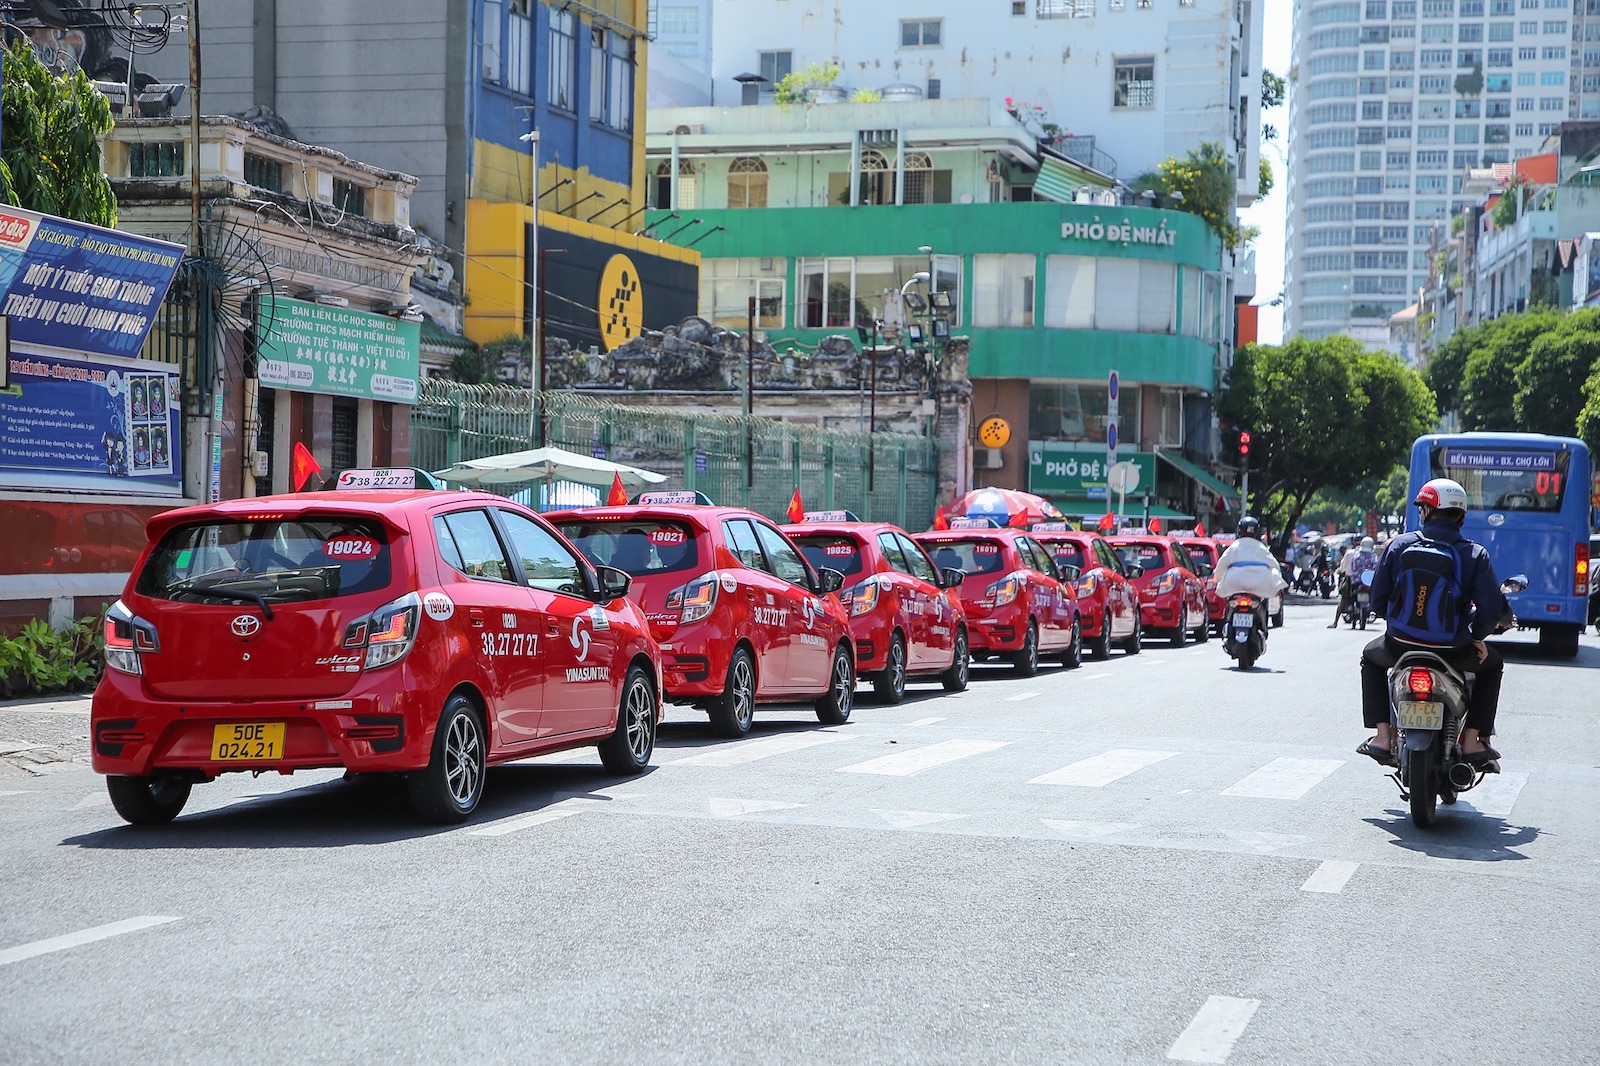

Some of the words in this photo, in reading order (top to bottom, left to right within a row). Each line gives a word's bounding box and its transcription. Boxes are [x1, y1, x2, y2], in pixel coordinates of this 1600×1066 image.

[6, 219, 27, 240] dục
[1061, 215, 1104, 240] PHỞ
[1107, 217, 1131, 247] ĐỆ
[1132, 217, 1177, 246] NHẤT
[47, 230, 64, 244] GIÁO
[94, 240, 108, 255] TẠO
[107, 242, 129, 257] THÀNH
[159, 255, 177, 268] MINH
[22, 262, 55, 290] MỘT
[50, 265, 65, 288] Ý
[59, 269, 94, 294] THỨC
[90, 276, 120, 299] GIAO
[117, 280, 155, 305] THÔNG
[2, 293, 42, 321] TRIỆU
[37, 300, 60, 325] NỤ
[56, 301, 89, 326] CƯỜI
[83, 307, 119, 333] HẠNH
[114, 312, 147, 336] PHÚC
[291, 306, 310, 317] BAN
[311, 308, 331, 320] LIÊN
[333, 312, 349, 324] LẠC
[350, 315, 366, 327] HỌC
[368, 319, 385, 330] SINH
[278, 317, 313, 331] TRƯỜNG
[315, 323, 337, 335] THCS
[339, 327, 361, 339] MẠCH
[364, 328, 384, 342] KIẾM
[385, 332, 405, 346] HÙNG
[276, 331, 310, 346] TRƯỜNG
[313, 336, 329, 349] TUỆ
[332, 338, 358, 352] THÀNH
[366, 343, 383, 357] VIỆT
[385, 346, 394, 358] TÚ
[1046, 458, 1078, 476] PHỞ
[1081, 459, 1100, 480] ĐỆ
[1451, 453, 1466, 464] BẾN
[1468, 454, 1494, 465] THÀNH
[1501, 456, 1514, 466] BX.
[1515, 456, 1532, 468] CHỢ
[1534, 456, 1550, 467] LỚN
[357, 478, 370, 486] 38
[373, 477, 385, 486] 27
[388, 476, 400, 485] 27
[402, 476, 414, 485] 27
[1536, 472, 1561, 495] 01
[652, 531, 684, 542] 19021
[327, 540, 372, 555] 19024
[826, 546, 851, 555] 19025
[428, 598, 450, 614] 19024
[1416, 585, 1428, 617] adidas
[512, 633, 524, 656] 27
[526, 633, 538, 656] 27
[565, 667, 596, 682] VINASUN
[596, 666, 609, 680] TAXI
[1405, 703, 1437, 715] 71-C4
[1401, 715, 1440, 728] 040.87
[234, 725, 265, 740] 50E
[219, 742, 274, 758] 024.21
